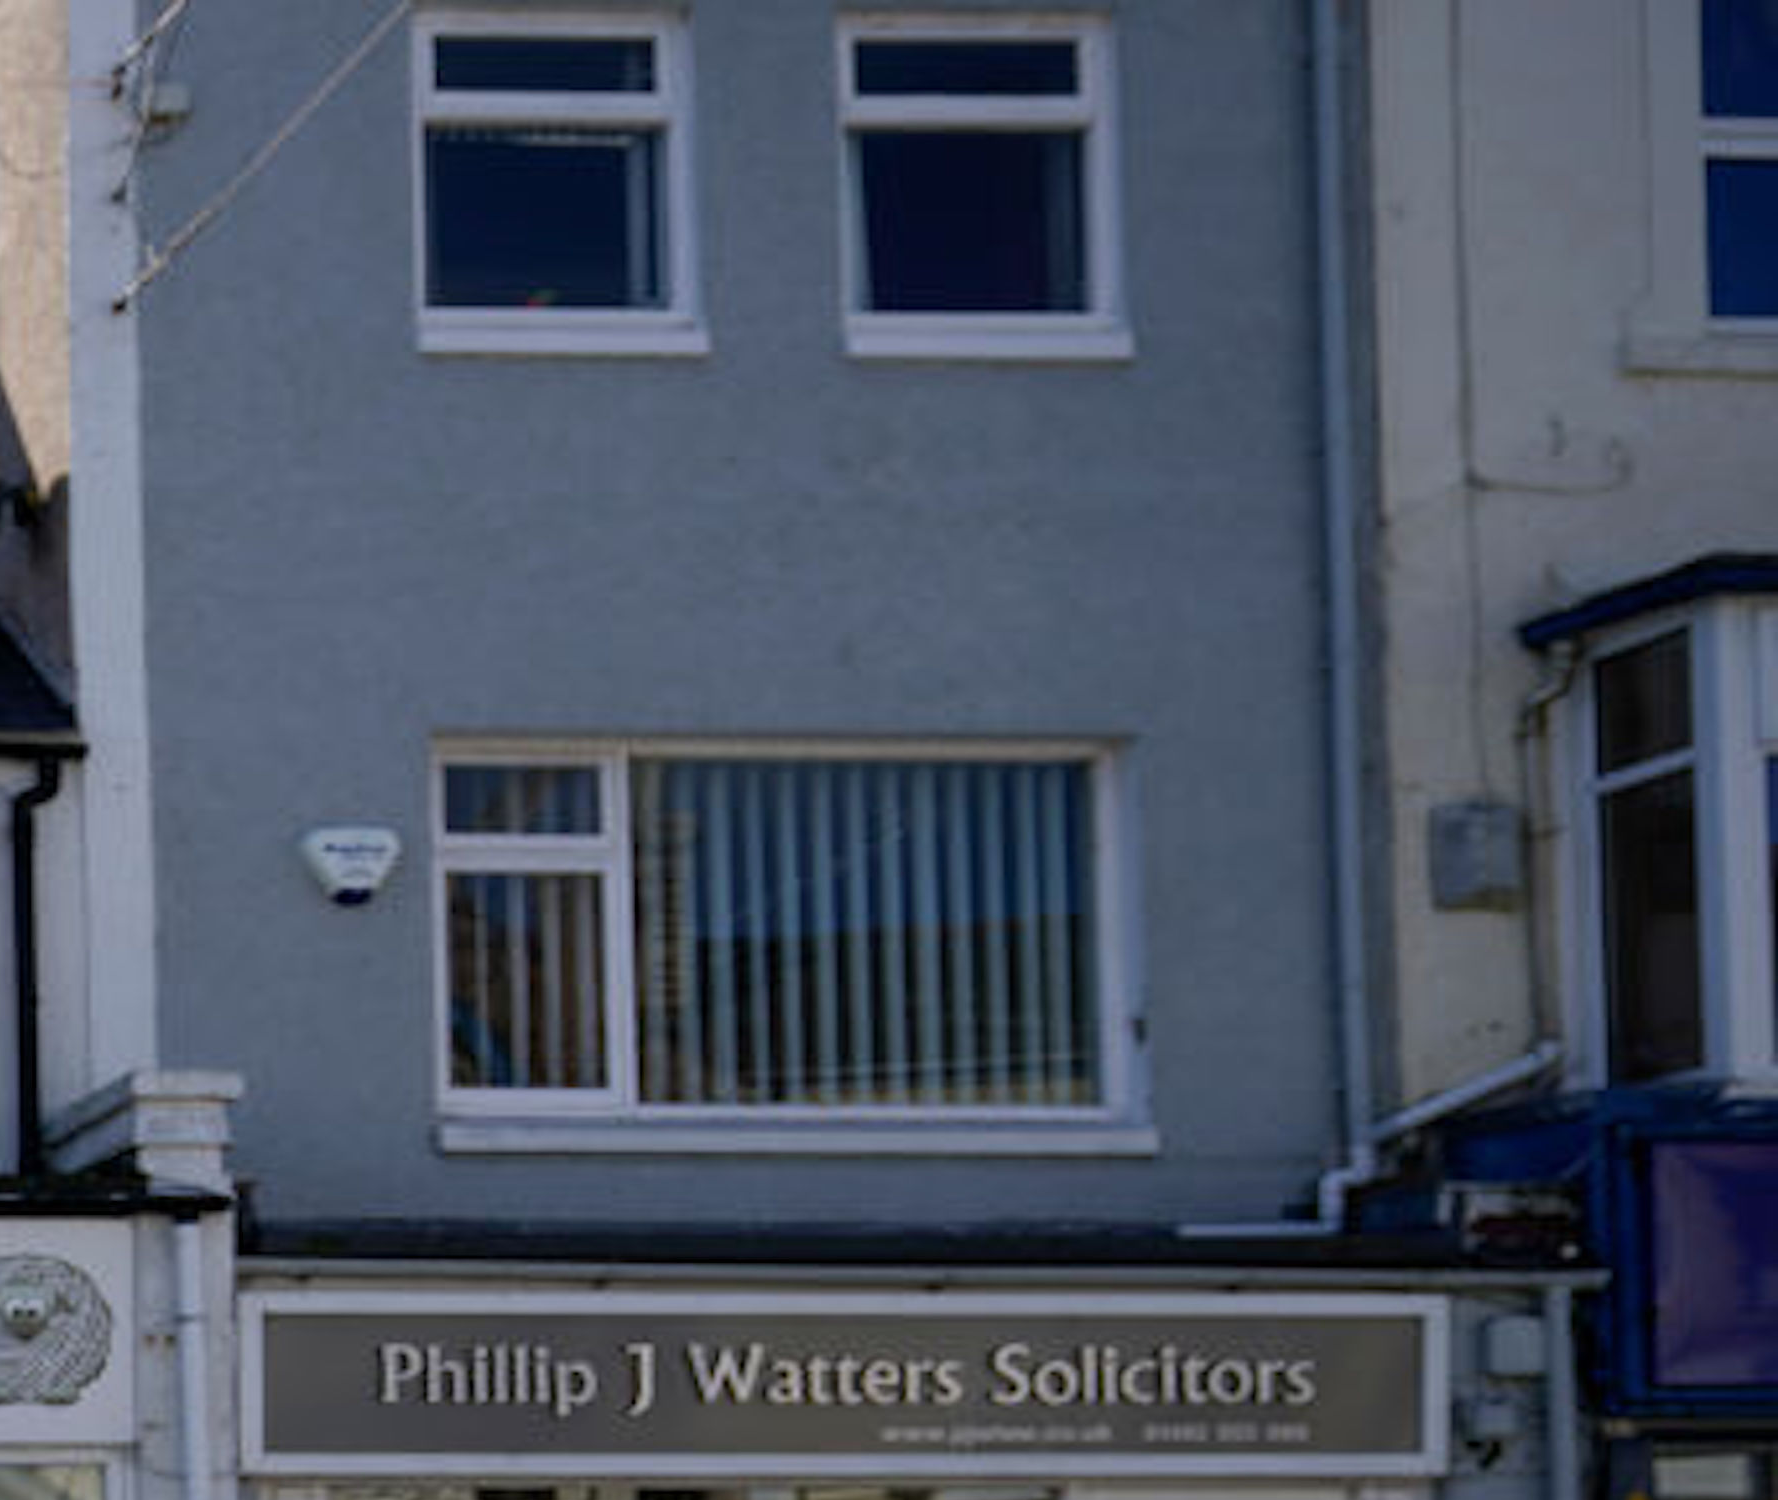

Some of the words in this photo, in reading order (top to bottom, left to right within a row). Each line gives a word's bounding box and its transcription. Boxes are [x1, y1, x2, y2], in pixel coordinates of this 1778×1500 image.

[382, 1342, 598, 1417] Phillip
[626, 1343, 655, 1416] J
[690, 1343, 964, 1404] Watters
[993, 1342, 1315, 1405] Solicitors
